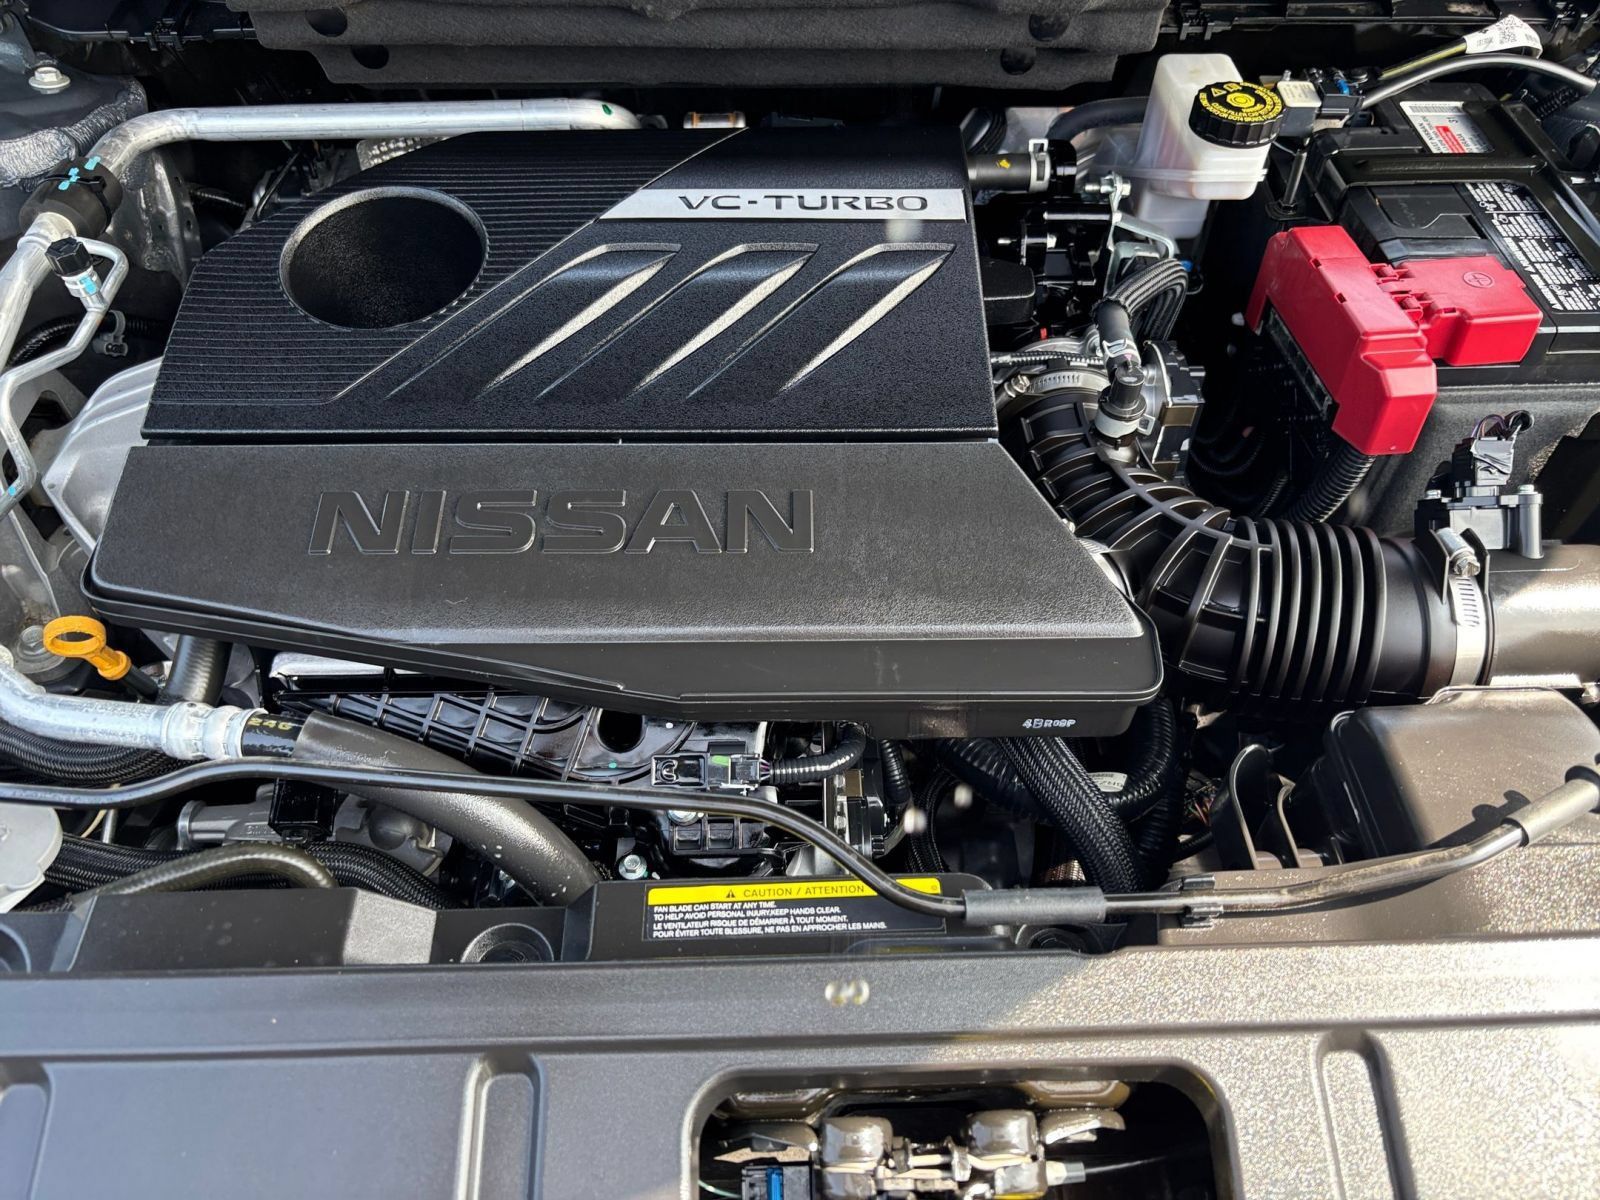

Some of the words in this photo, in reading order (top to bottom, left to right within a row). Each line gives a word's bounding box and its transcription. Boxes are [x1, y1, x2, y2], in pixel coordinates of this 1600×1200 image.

[678, 195, 928, 211] VC-TURBO
[308, 489, 815, 555] NISSAN
[743, 887, 792, 897] CAUTION
[805, 885, 864, 895] ATTENTION
[653, 905, 668, 913] FAN
[669, 904, 693, 913] BLADE
[693, 903, 710, 911] CAN
[710, 902, 732, 910] START
[742, 901, 758, 909] ANY
[759, 900, 777, 908] TIME.
[653, 913, 664, 921] TO
[664, 912, 684, 920] HELP
[684, 911, 707, 920] AVOID
[707, 910, 745, 918] PERSONAL
[790, 907, 815, 915] HANDS
[816, 905, 841, 914] CLEAR.
[652, 922, 662, 930] LE
[663, 920, 709, 930] VENTILATEUR
[710, 919, 737, 927] RISQUE
[738, 918, 748, 926] DE
[749, 916, 789, 926] DÉMARRER
[789, 915, 795, 924] À
[815, 914, 848, 923] MOMENT.
[652, 930, 674, 938] POUR
[674, 928, 700, 937] ÉVITER
[700, 927, 723, 935] TOUTE
[724, 926, 763, 935] BLESSURE,
[764, 925, 776, 933] NE
[776, 925, 791, 933] PAS
[802, 923, 847, 932] APPROCHER
[848, 922, 862, 930] LES
[862, 921, 887, 929] MAINS.
